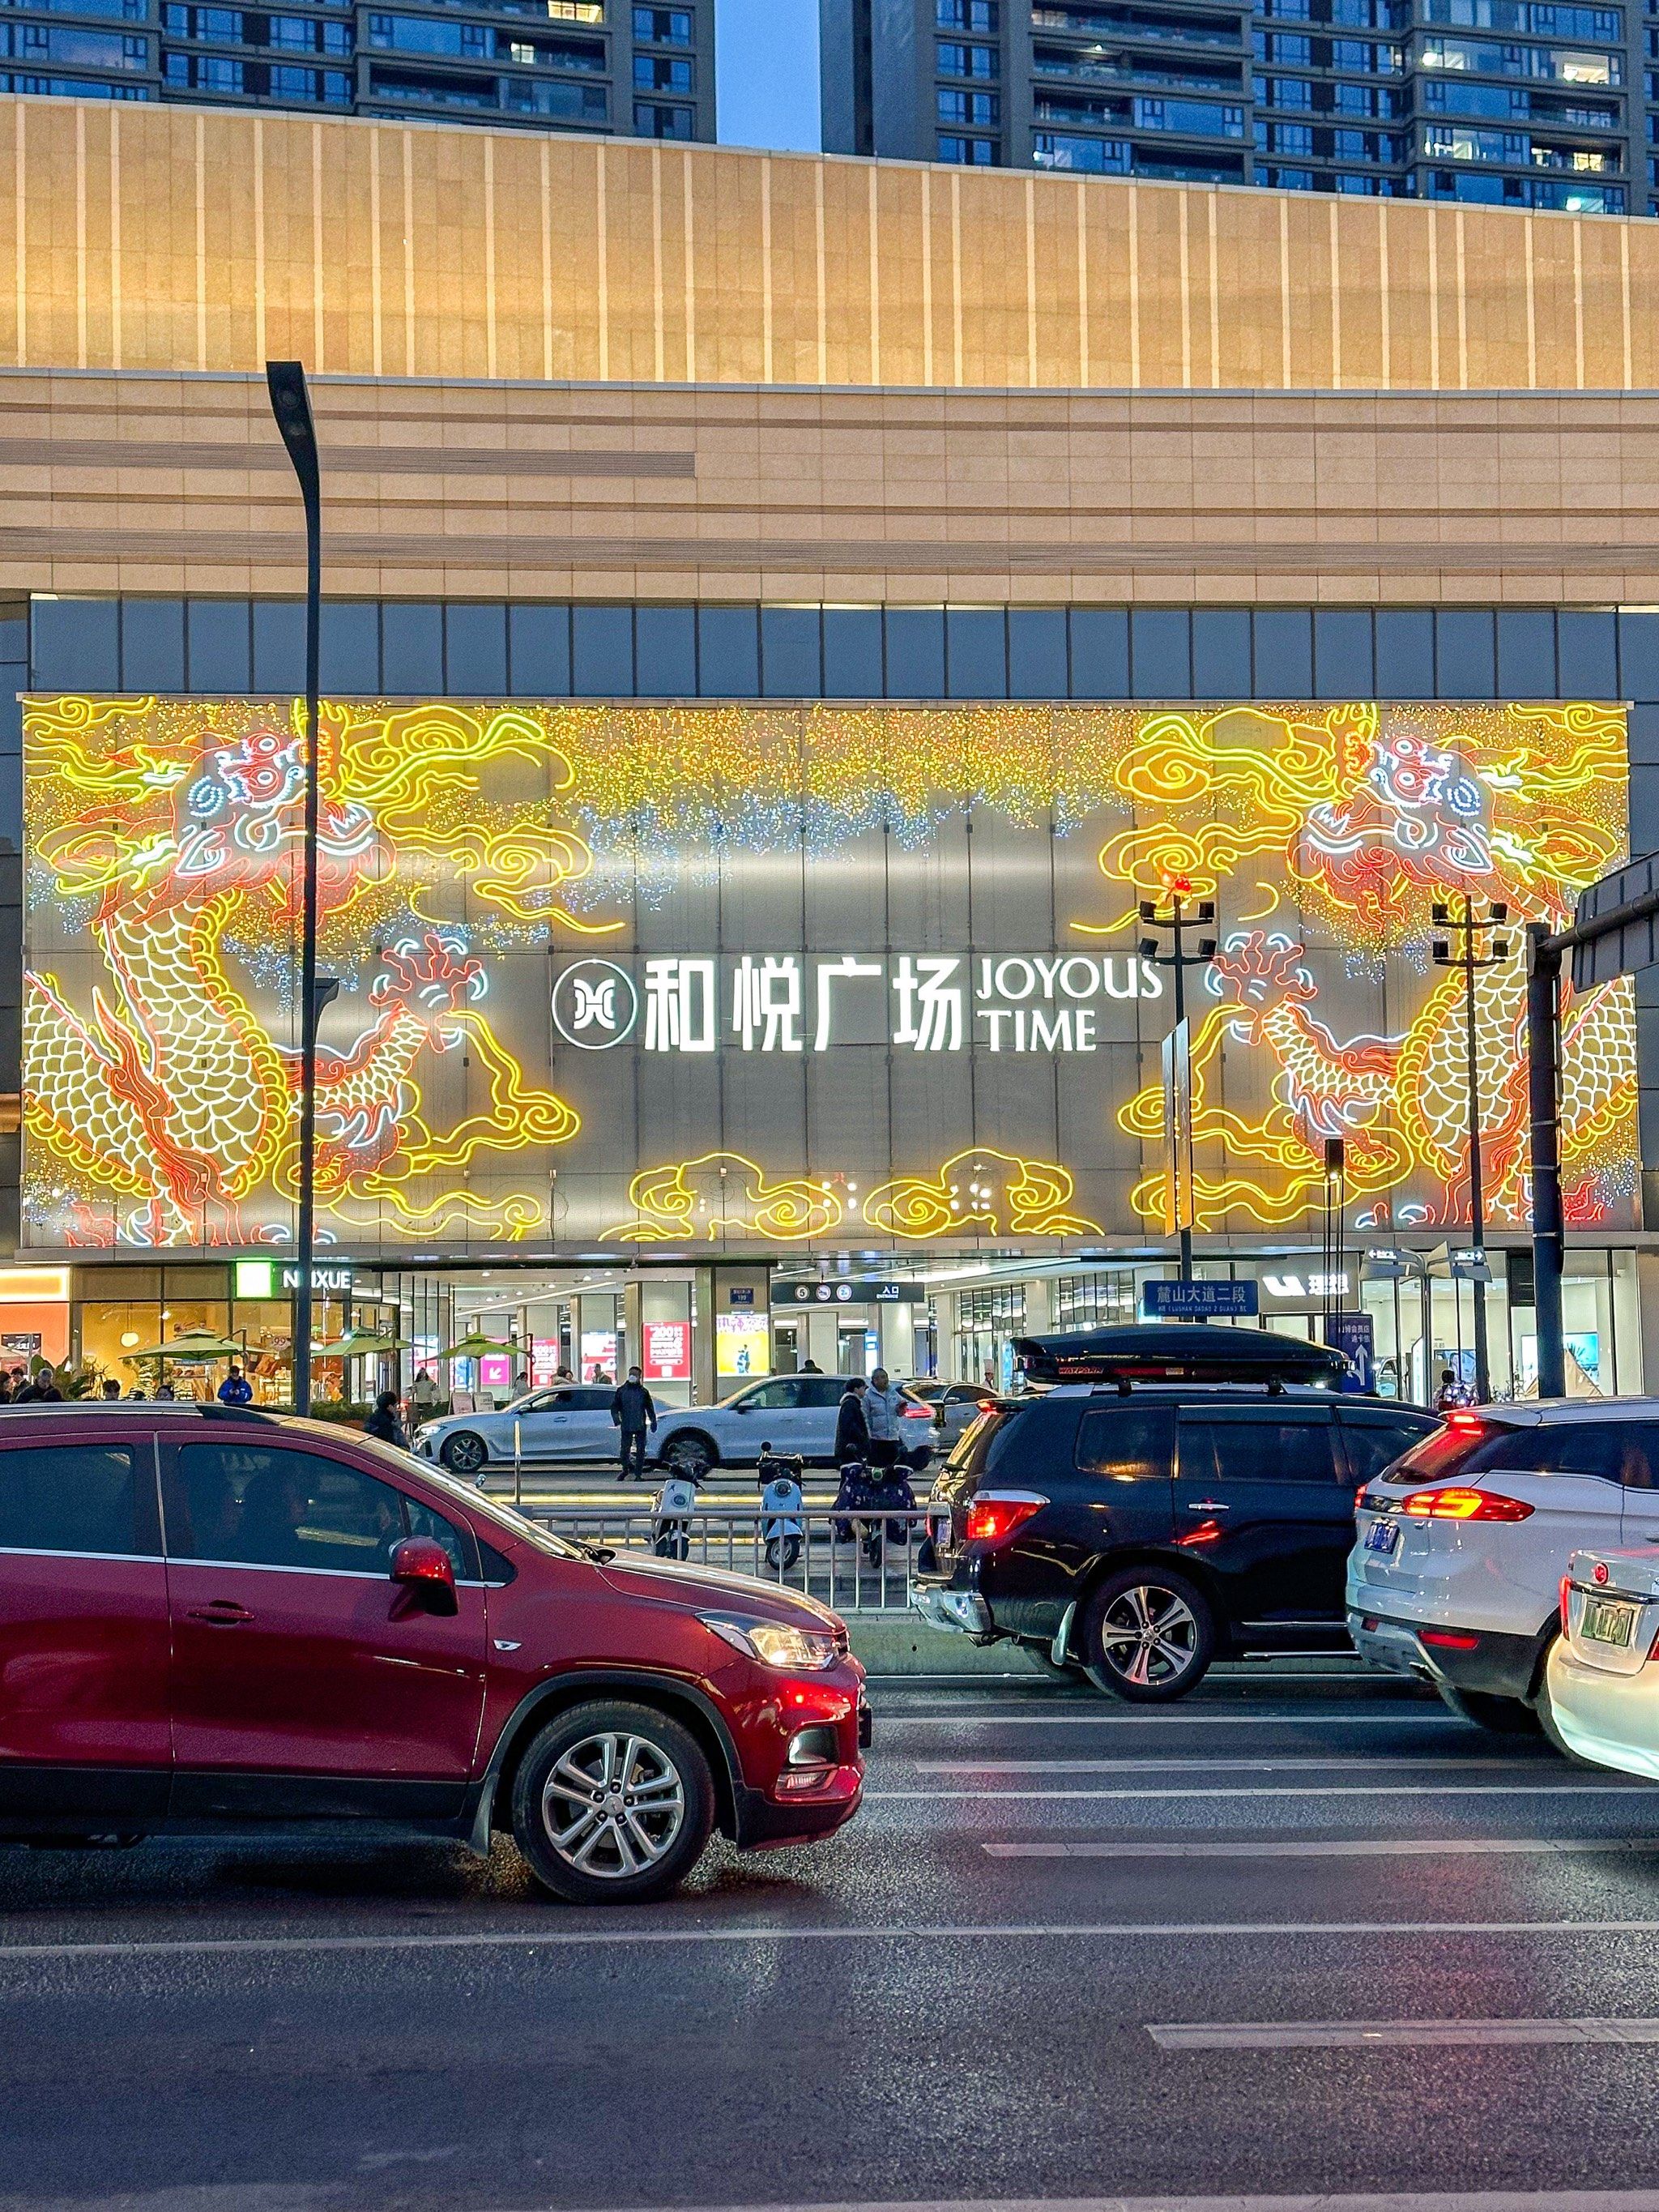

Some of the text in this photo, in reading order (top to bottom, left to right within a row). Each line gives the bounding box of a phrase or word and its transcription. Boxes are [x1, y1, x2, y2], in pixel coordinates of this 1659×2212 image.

[975, 957, 1163, 1000] JOYOUS
[644, 956, 962, 1052] 和悦广场
[977, 1010, 1097, 1052] TIME
[283, 1270, 352, 1288] NIXUE
[882, 1286, 899, 1294] 入口
[1157, 1285, 1246, 1303] 麓山大道二段
